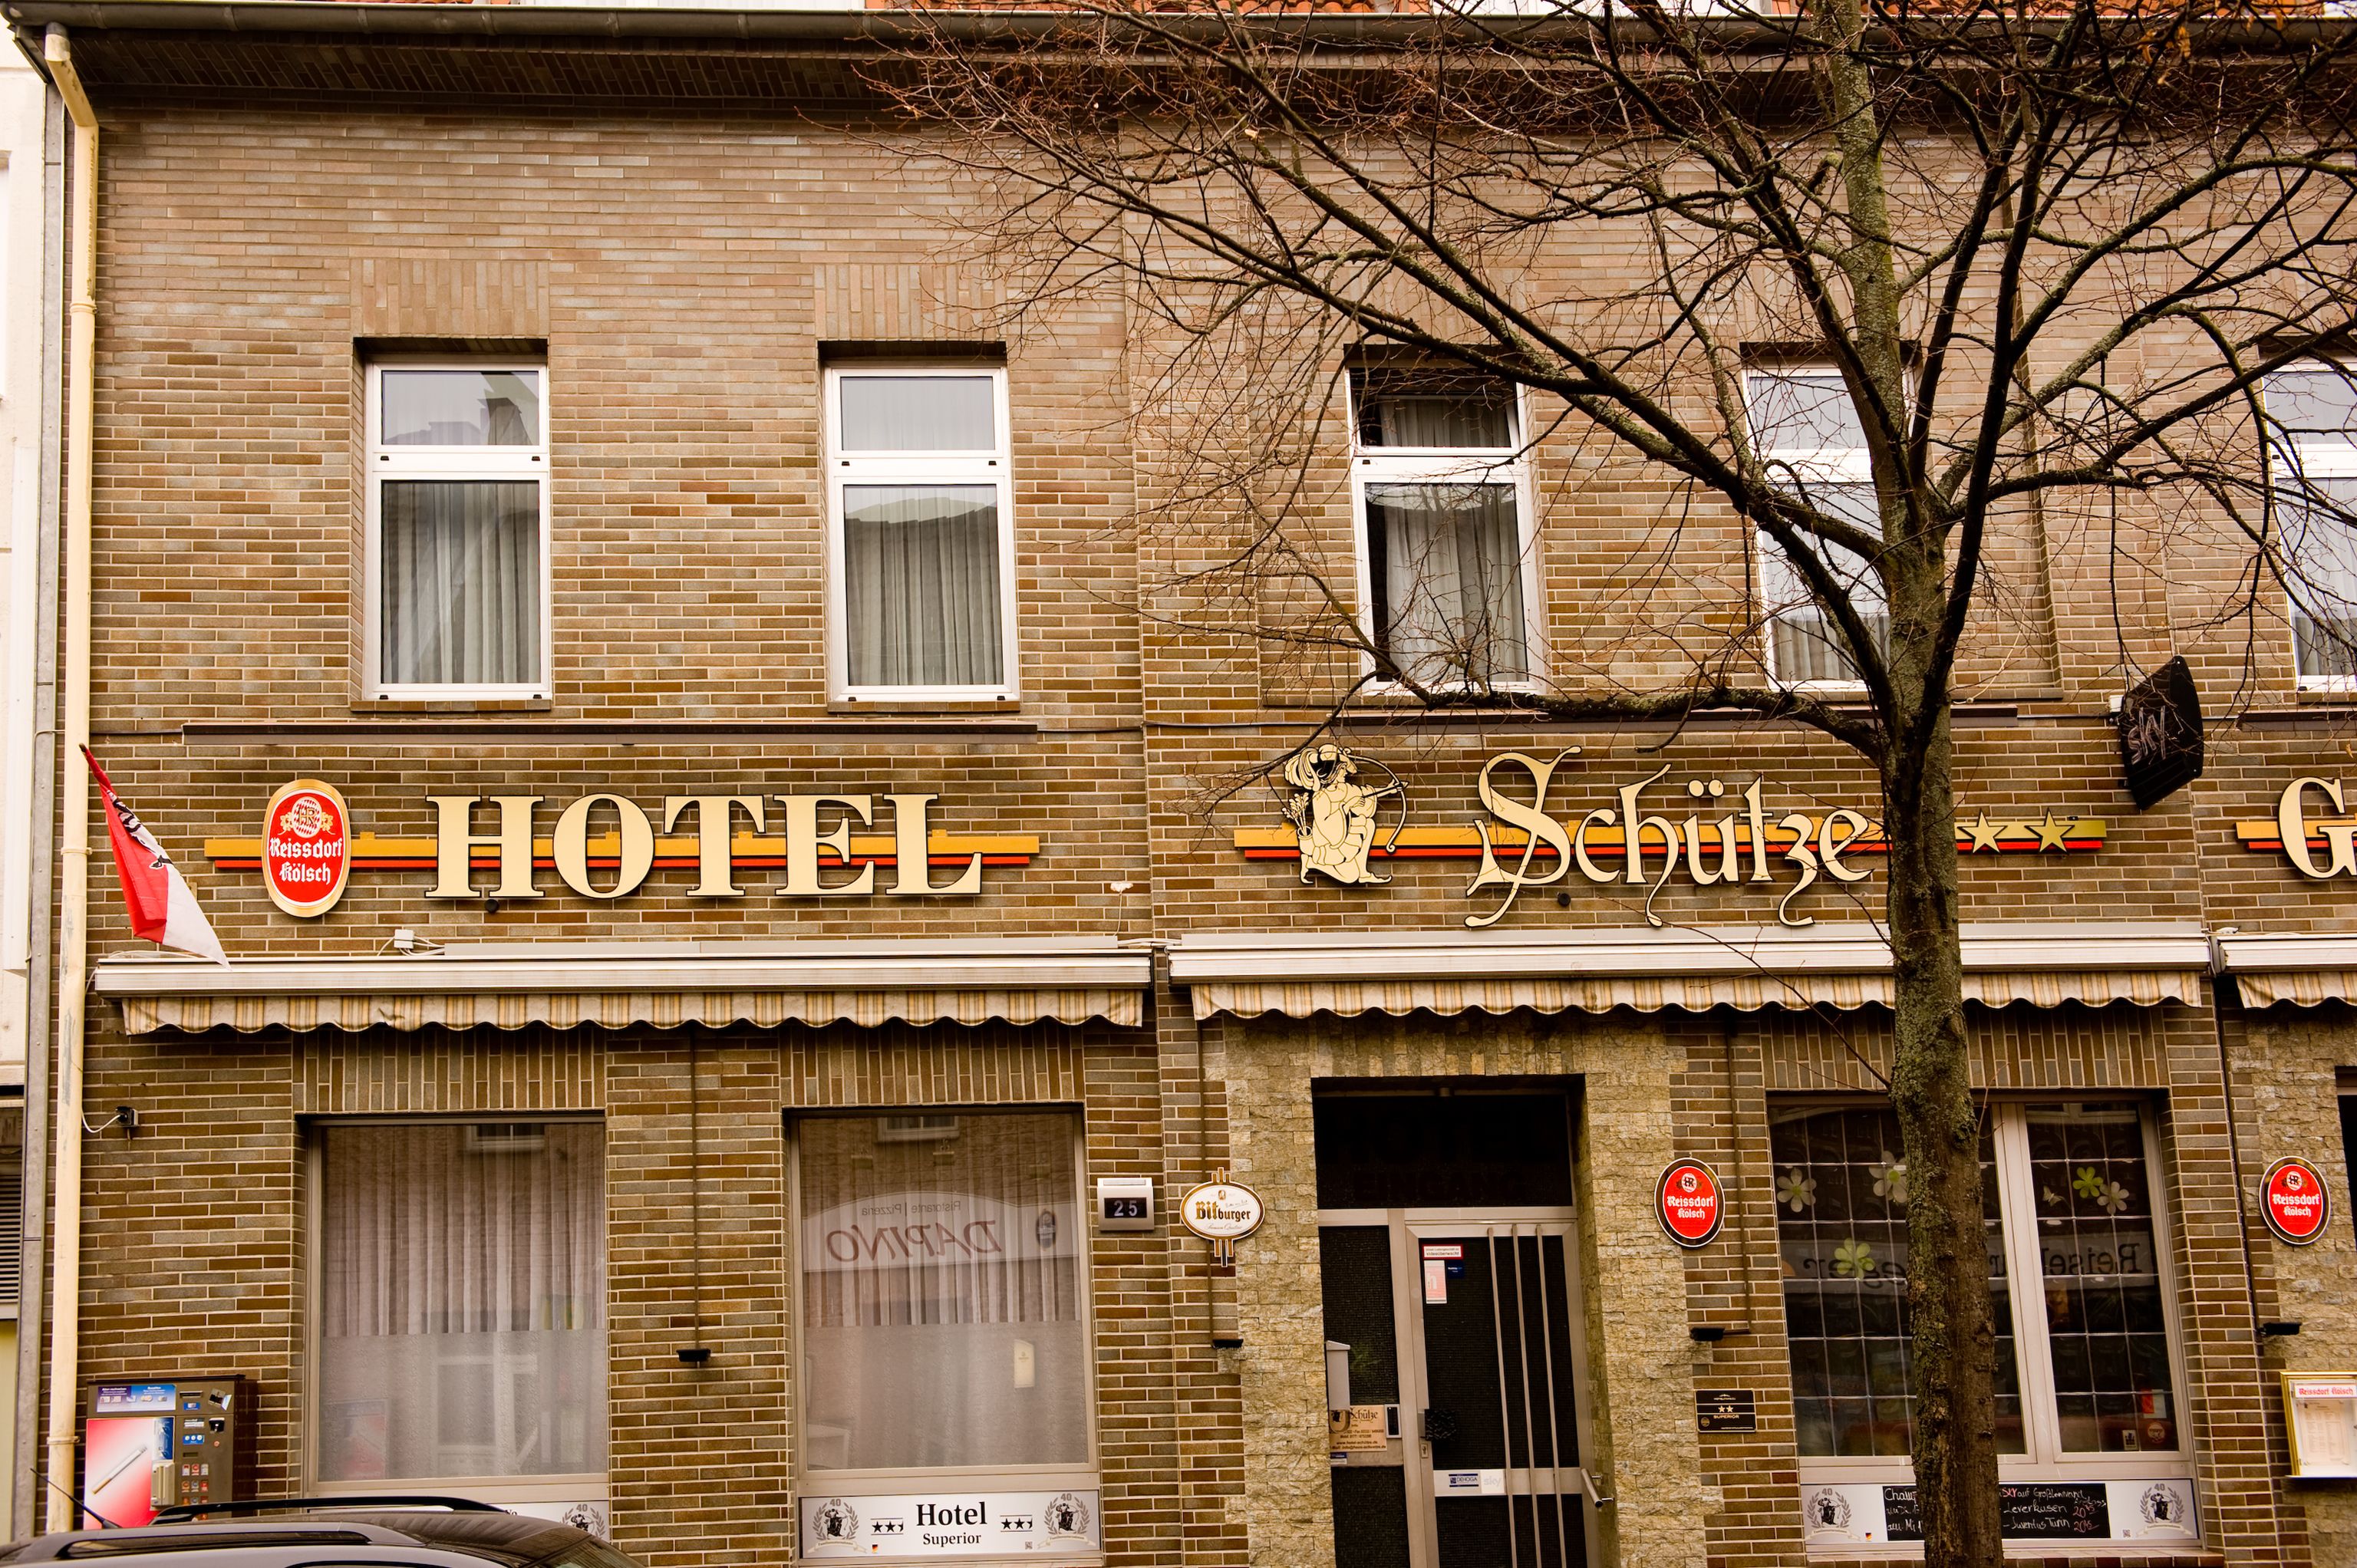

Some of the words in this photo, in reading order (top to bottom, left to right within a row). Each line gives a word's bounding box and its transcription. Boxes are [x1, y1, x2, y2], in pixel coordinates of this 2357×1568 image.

[1464, 745, 1874, 927] Schütze
[269, 837, 343, 858] Reissdorf
[424, 792, 982, 899] HOTEL
[279, 861, 331, 884] Kölsch
[1667, 1195, 1714, 1207] Reissdorf
[2273, 1194, 2319, 1205] Reissdorf
[1113, 1200, 1138, 1217] 25
[1195, 1201, 1251, 1222] Bitburger
[1677, 1207, 1706, 1220] Kölsch
[2283, 1205, 2312, 1217] Kölsch
[1821, 1487, 1833, 1497] 40
[2154, 1483, 2166, 1491] 40
[829, 1498, 842, 1507] 40
[1061, 1493, 1073, 1501] 40
[576, 1504, 588, 1512] 40
[916, 1501, 987, 1527] Hotel
[2044, 1517, 2071, 1529] Turin
[923, 1533, 981, 1547] Superior
